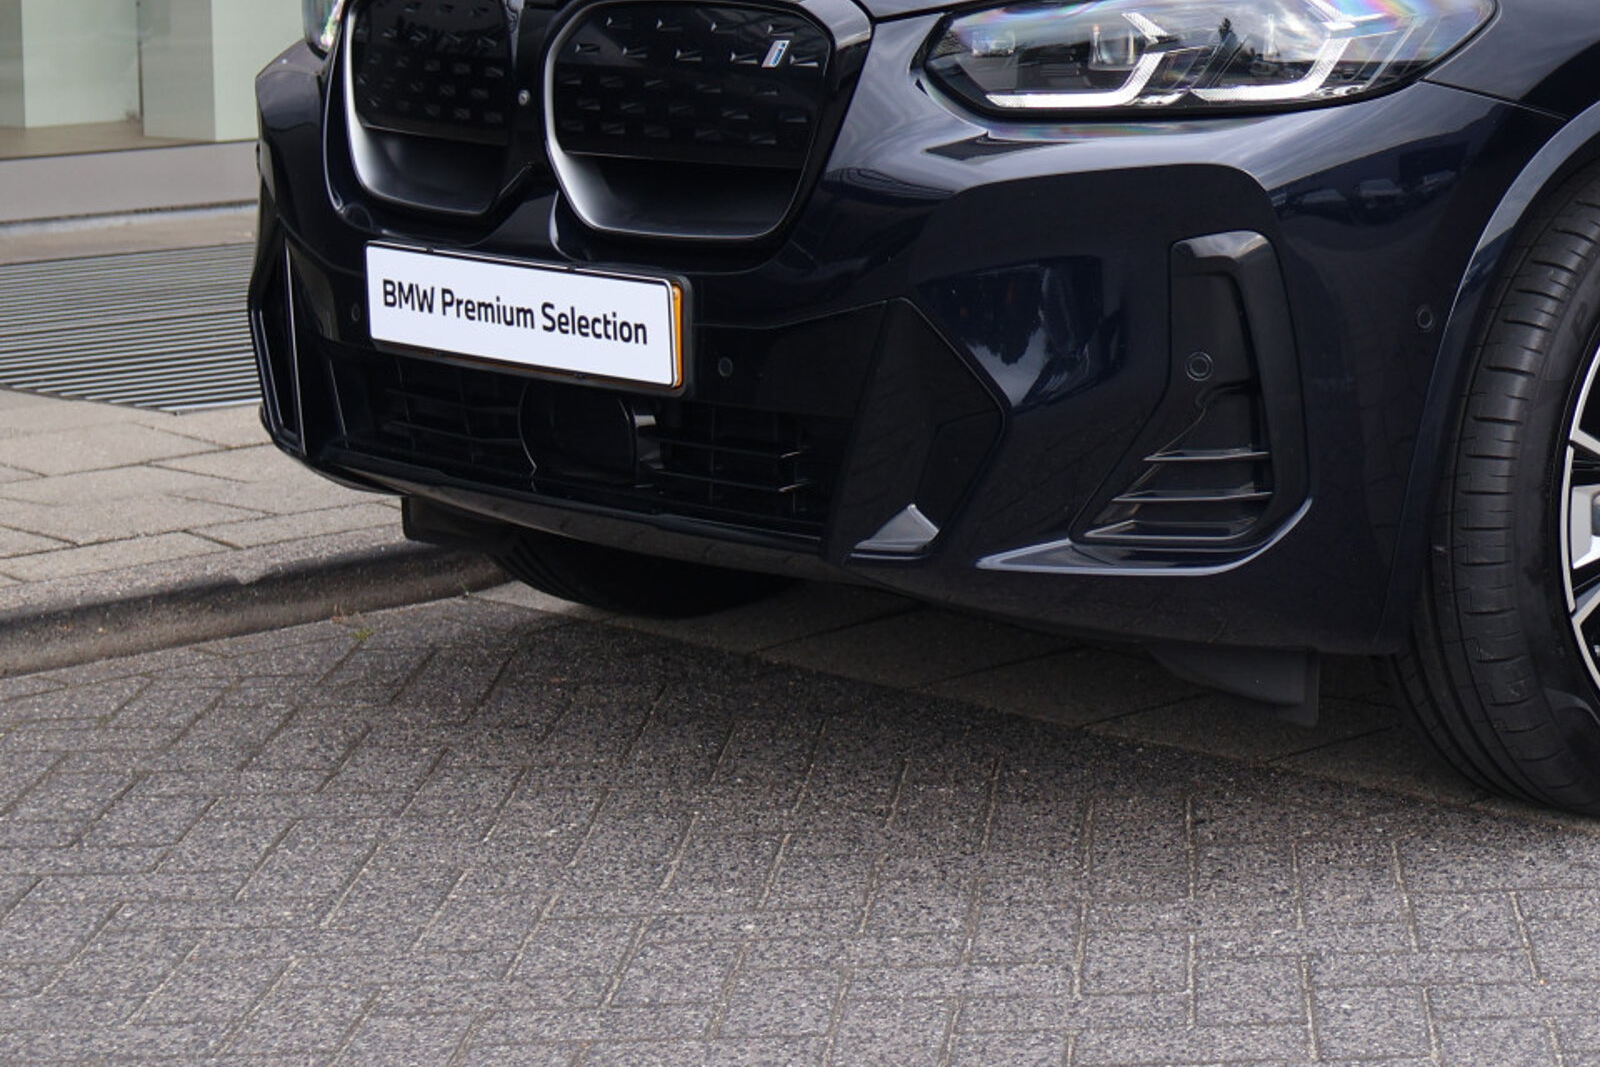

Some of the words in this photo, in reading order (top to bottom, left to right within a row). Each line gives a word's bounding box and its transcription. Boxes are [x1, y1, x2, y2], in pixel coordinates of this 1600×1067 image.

[382, 278, 435, 314] BMW
[441, 287, 535, 330] Premium
[541, 301, 648, 345] Selection
